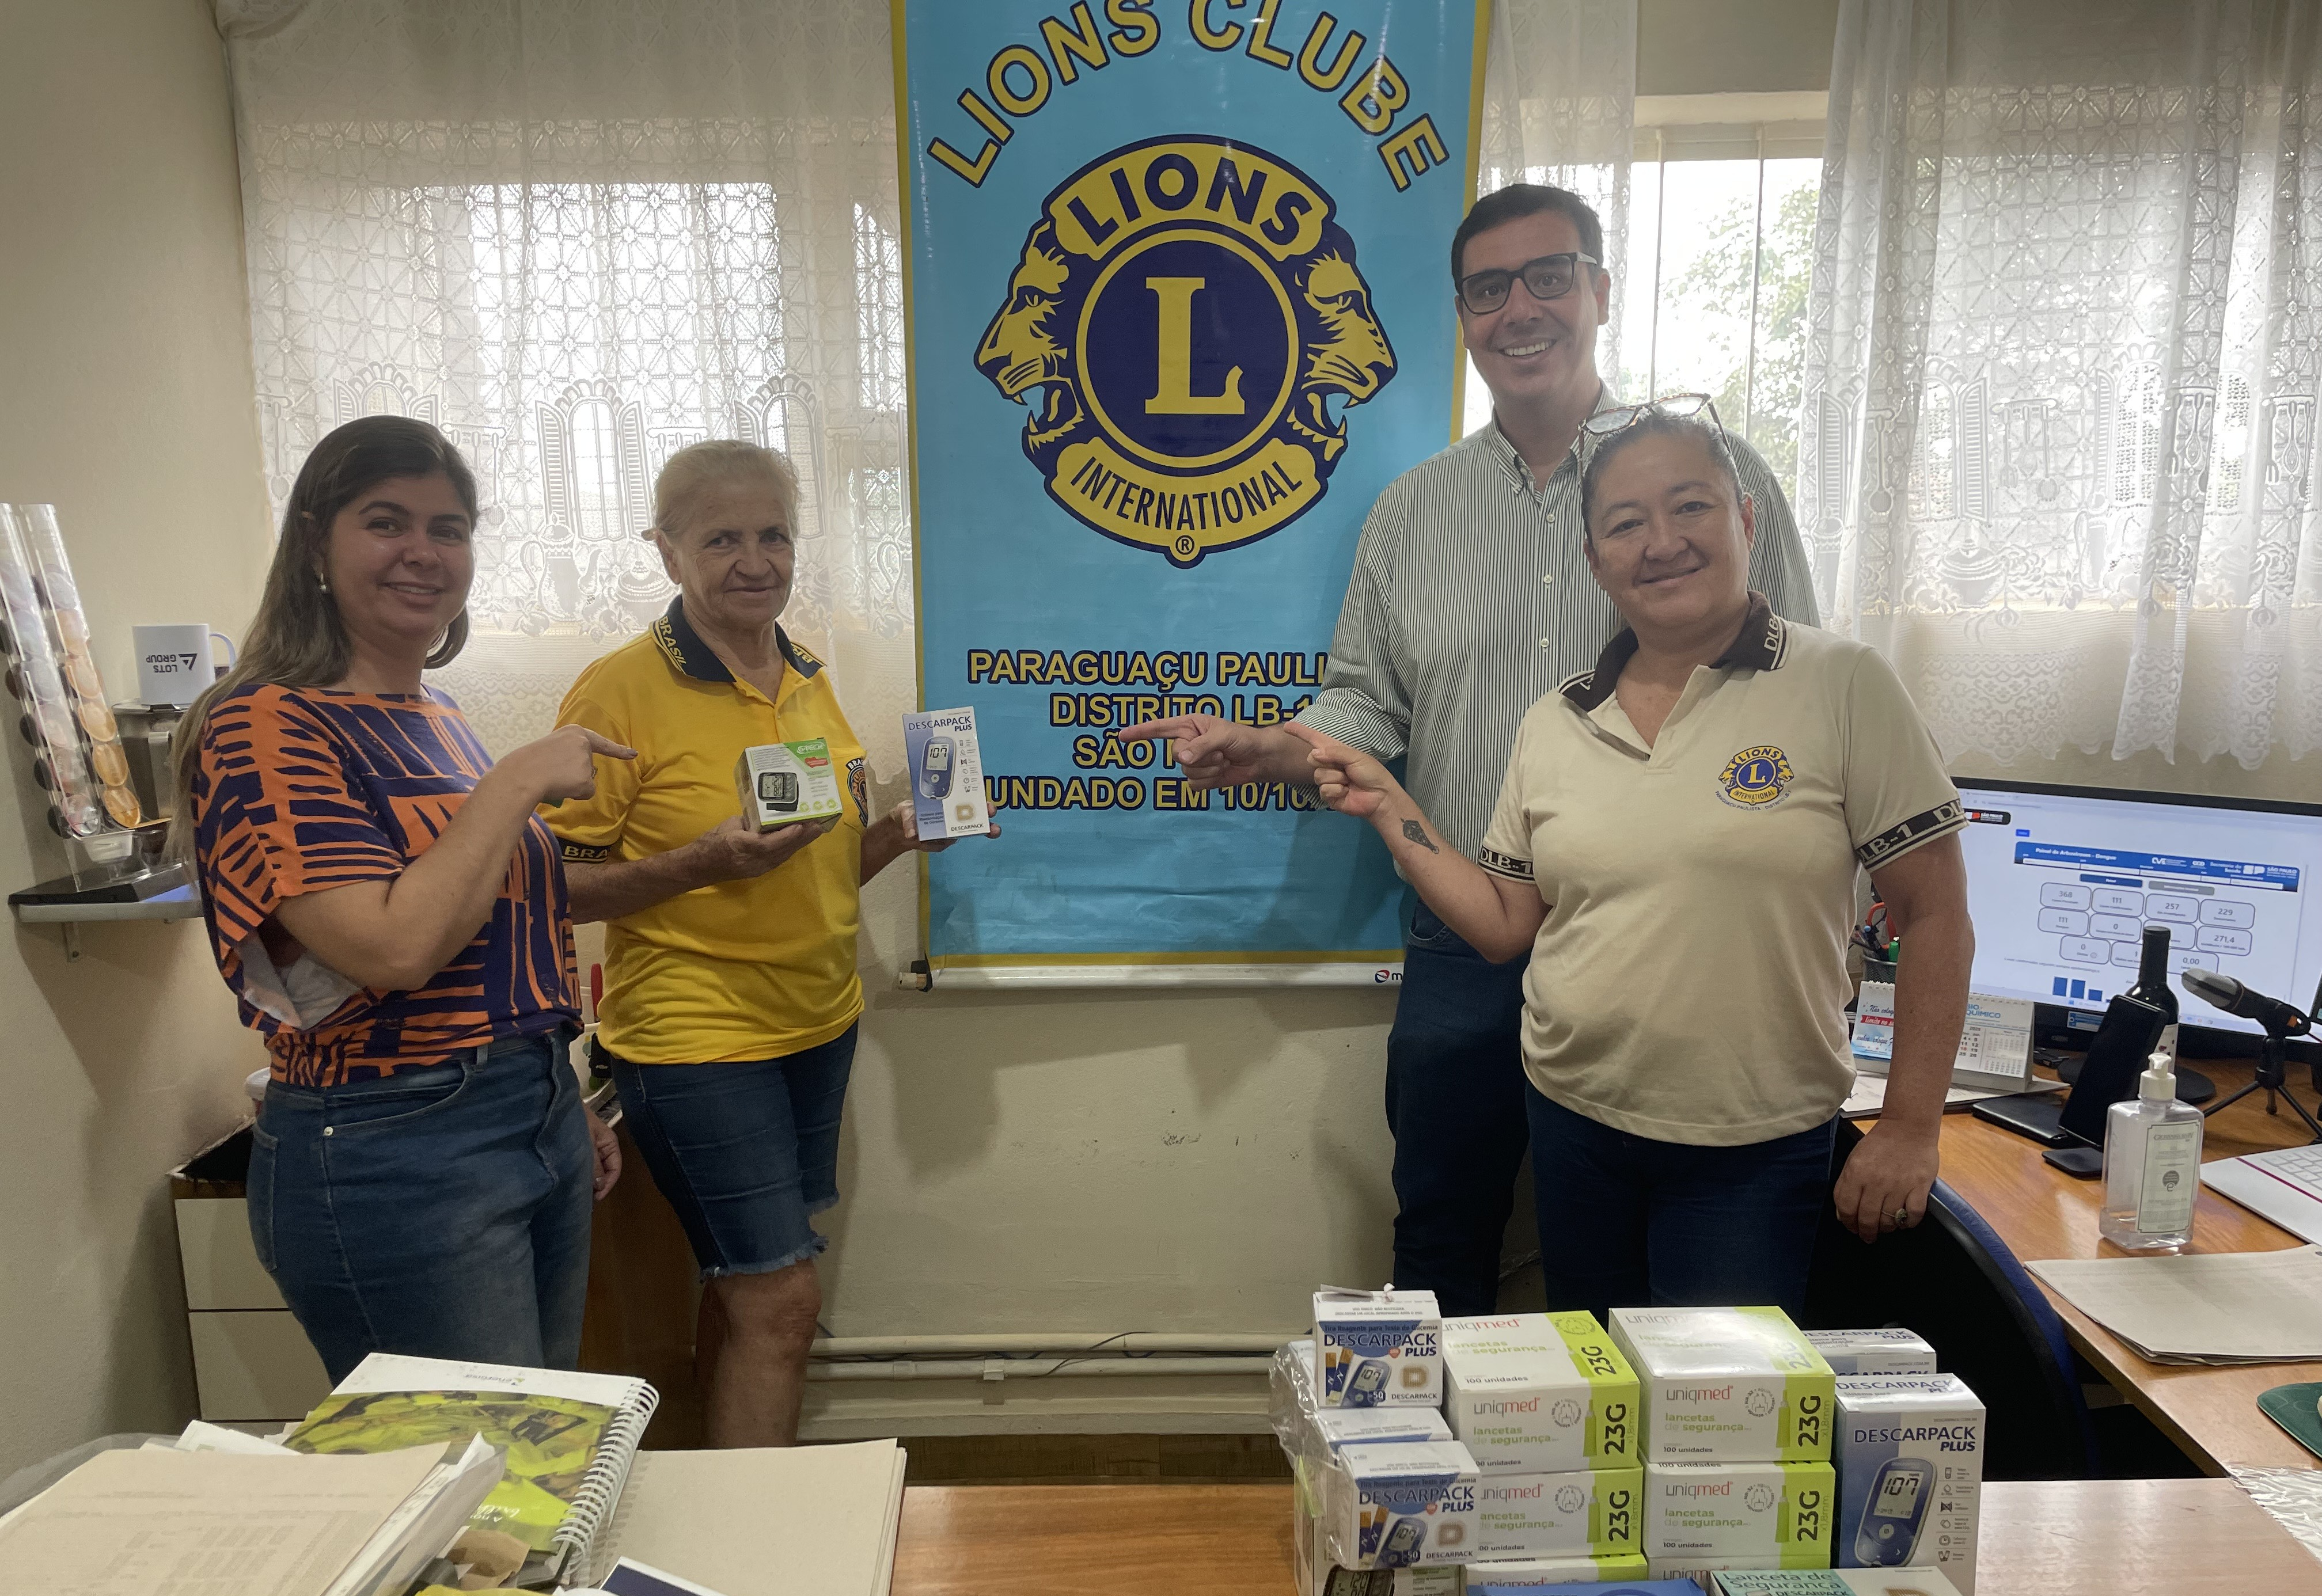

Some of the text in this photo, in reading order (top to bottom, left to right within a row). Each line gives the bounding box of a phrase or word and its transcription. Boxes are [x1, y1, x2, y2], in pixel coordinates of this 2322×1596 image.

[927, 0, 1450, 193] LIONS CLUBE
[1067, 153, 1315, 246] LIONS
[1145, 276, 1245, 415] L
[1070, 457, 1303, 531] INTERNATIONAL
[658, 615, 687, 666] BRASIL
[146, 654, 176, 663] GROUP
[153, 664, 178, 673] LOTS
[968, 649, 1208, 691] PARAGUAÇU
[1049, 692, 1224, 728] DISTRITO
[908, 716, 972, 731] DESCARPACK
[929, 747, 947, 758] 107
[1072, 732, 1157, 770] SÃO
[1737, 748, 1780, 762] LIONS
[1747, 763, 1766, 784] L
[1153, 778, 1211, 811] EM
[1733, 789, 1775, 801] INTERNATIONAL
[951, 823, 984, 831] DESCARPACK
[1858, 823, 1913, 862] LB-1
[2218, 908, 2233, 916] 229
[1324, 1332, 1436, 1347] DESCARPACK
[1448, 1340, 1508, 1349] lancetas
[1405, 1347, 1437, 1357] PLUS
[1472, 1344, 1547, 1355] segurança
[1581, 1346, 1618, 1376] 23G
[1360, 1369, 1381, 1381] 107
[1665, 1385, 1731, 1405] uniqmed
[1474, 1397, 1538, 1418] uniqmed
[1665, 1412, 1715, 1422] lancetas
[1798, 1396, 1821, 1447] 23G
[1473, 1426, 1523, 1435] lancetas
[1604, 1403, 1627, 1456] 23G
[1682, 1423, 1744, 1433] segurança
[1854, 1426, 1976, 1443] DESCARPACK
[1490, 1434, 1551, 1446] segurança
[1940, 1441, 1976, 1451] PLUS
[1449, 1476, 1477, 1484] Glicemia
[1884, 1477, 1919, 1496] 107
[1359, 1485, 1474, 1506] DESCARPACK
[1665, 1480, 1731, 1500] uniqmed
[1442, 1500, 1474, 1513] PLUS
[1665, 1507, 1714, 1517] lancetas
[1608, 1489, 1630, 1542] 23G
[1797, 1490, 1820, 1542] 23G
[1494, 1521, 1554, 1532] segurança
[1682, 1518, 1743, 1528] segurança
[1396, 1527, 1417, 1541] 107
[1426, 1551, 1473, 1559] DESCARPACK
[1722, 1572, 1832, 1582] Lanceta de
[1731, 1580, 1842, 1591] Segurança
